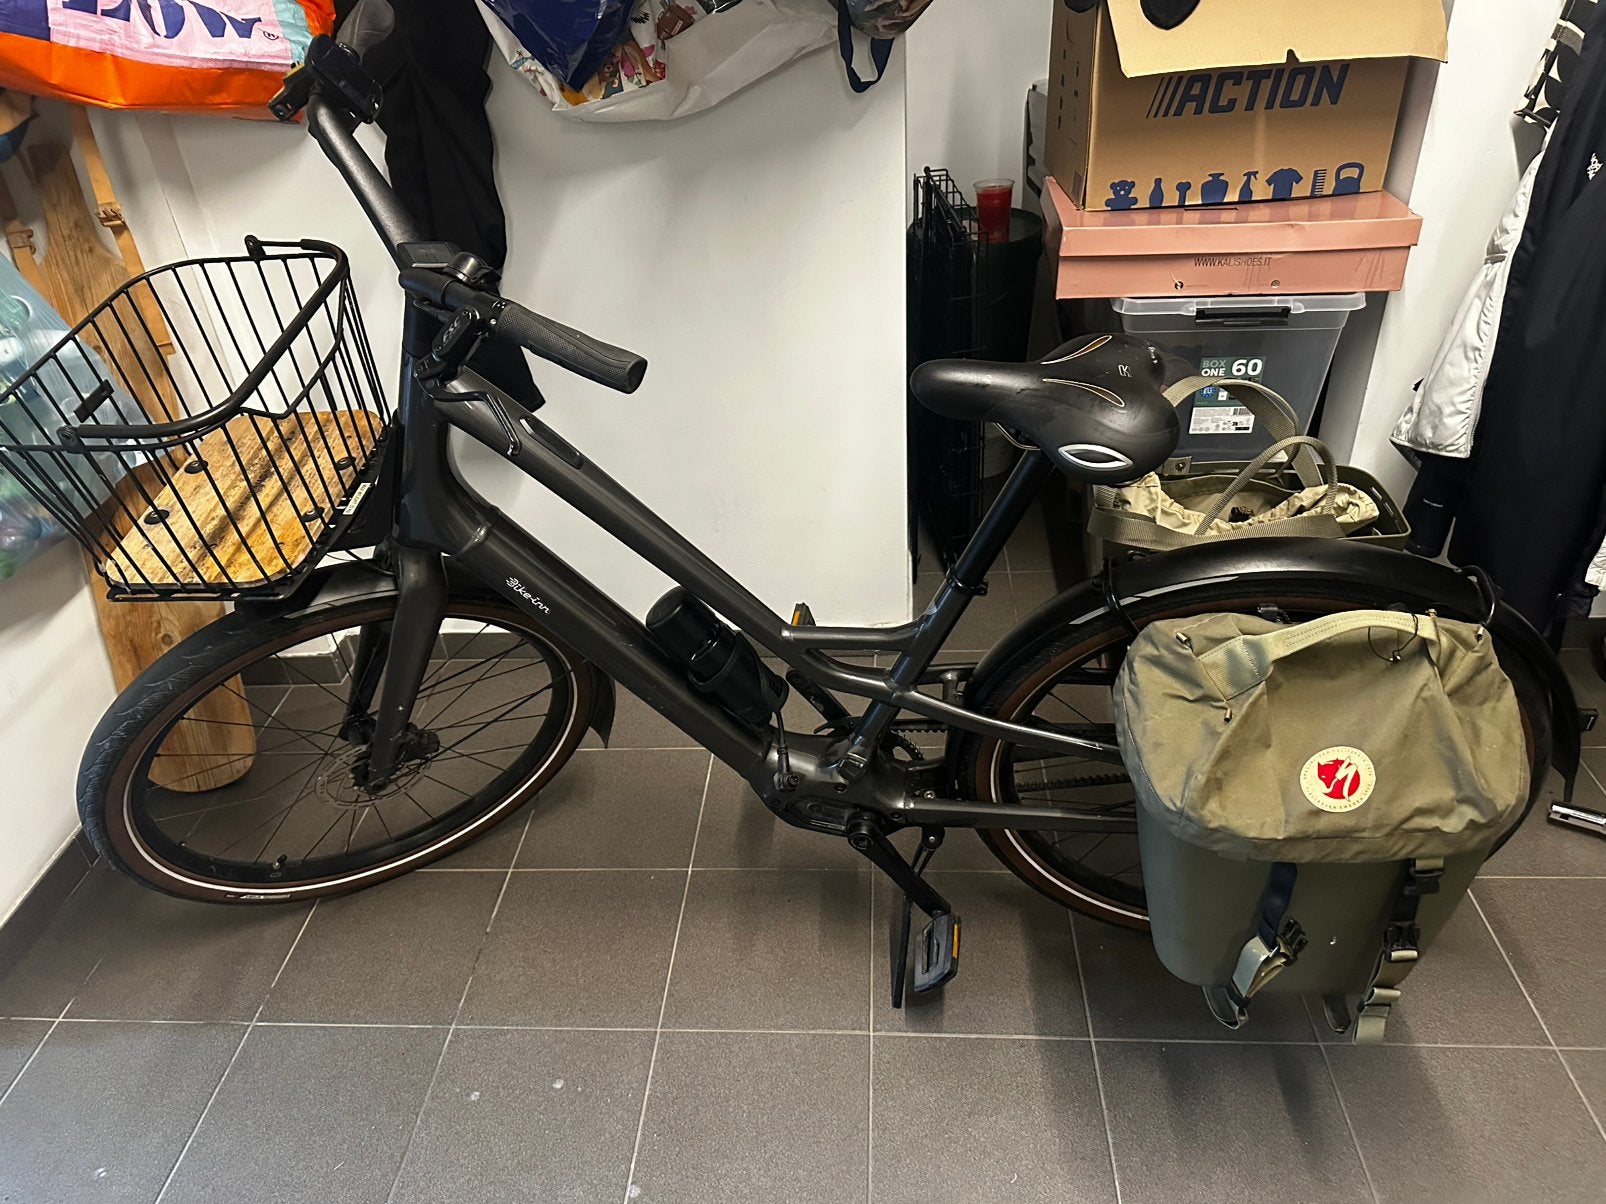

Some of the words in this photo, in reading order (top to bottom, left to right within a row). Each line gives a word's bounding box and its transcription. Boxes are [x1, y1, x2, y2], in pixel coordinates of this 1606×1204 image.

[1172, 63, 1351, 117] ACTION
[1193, 256, 1273, 268] WWW.KALISHOES.IT
[1202, 359, 1227, 368] BOX
[1231, 358, 1263, 376] 60
[1201, 368, 1226, 377] ONE
